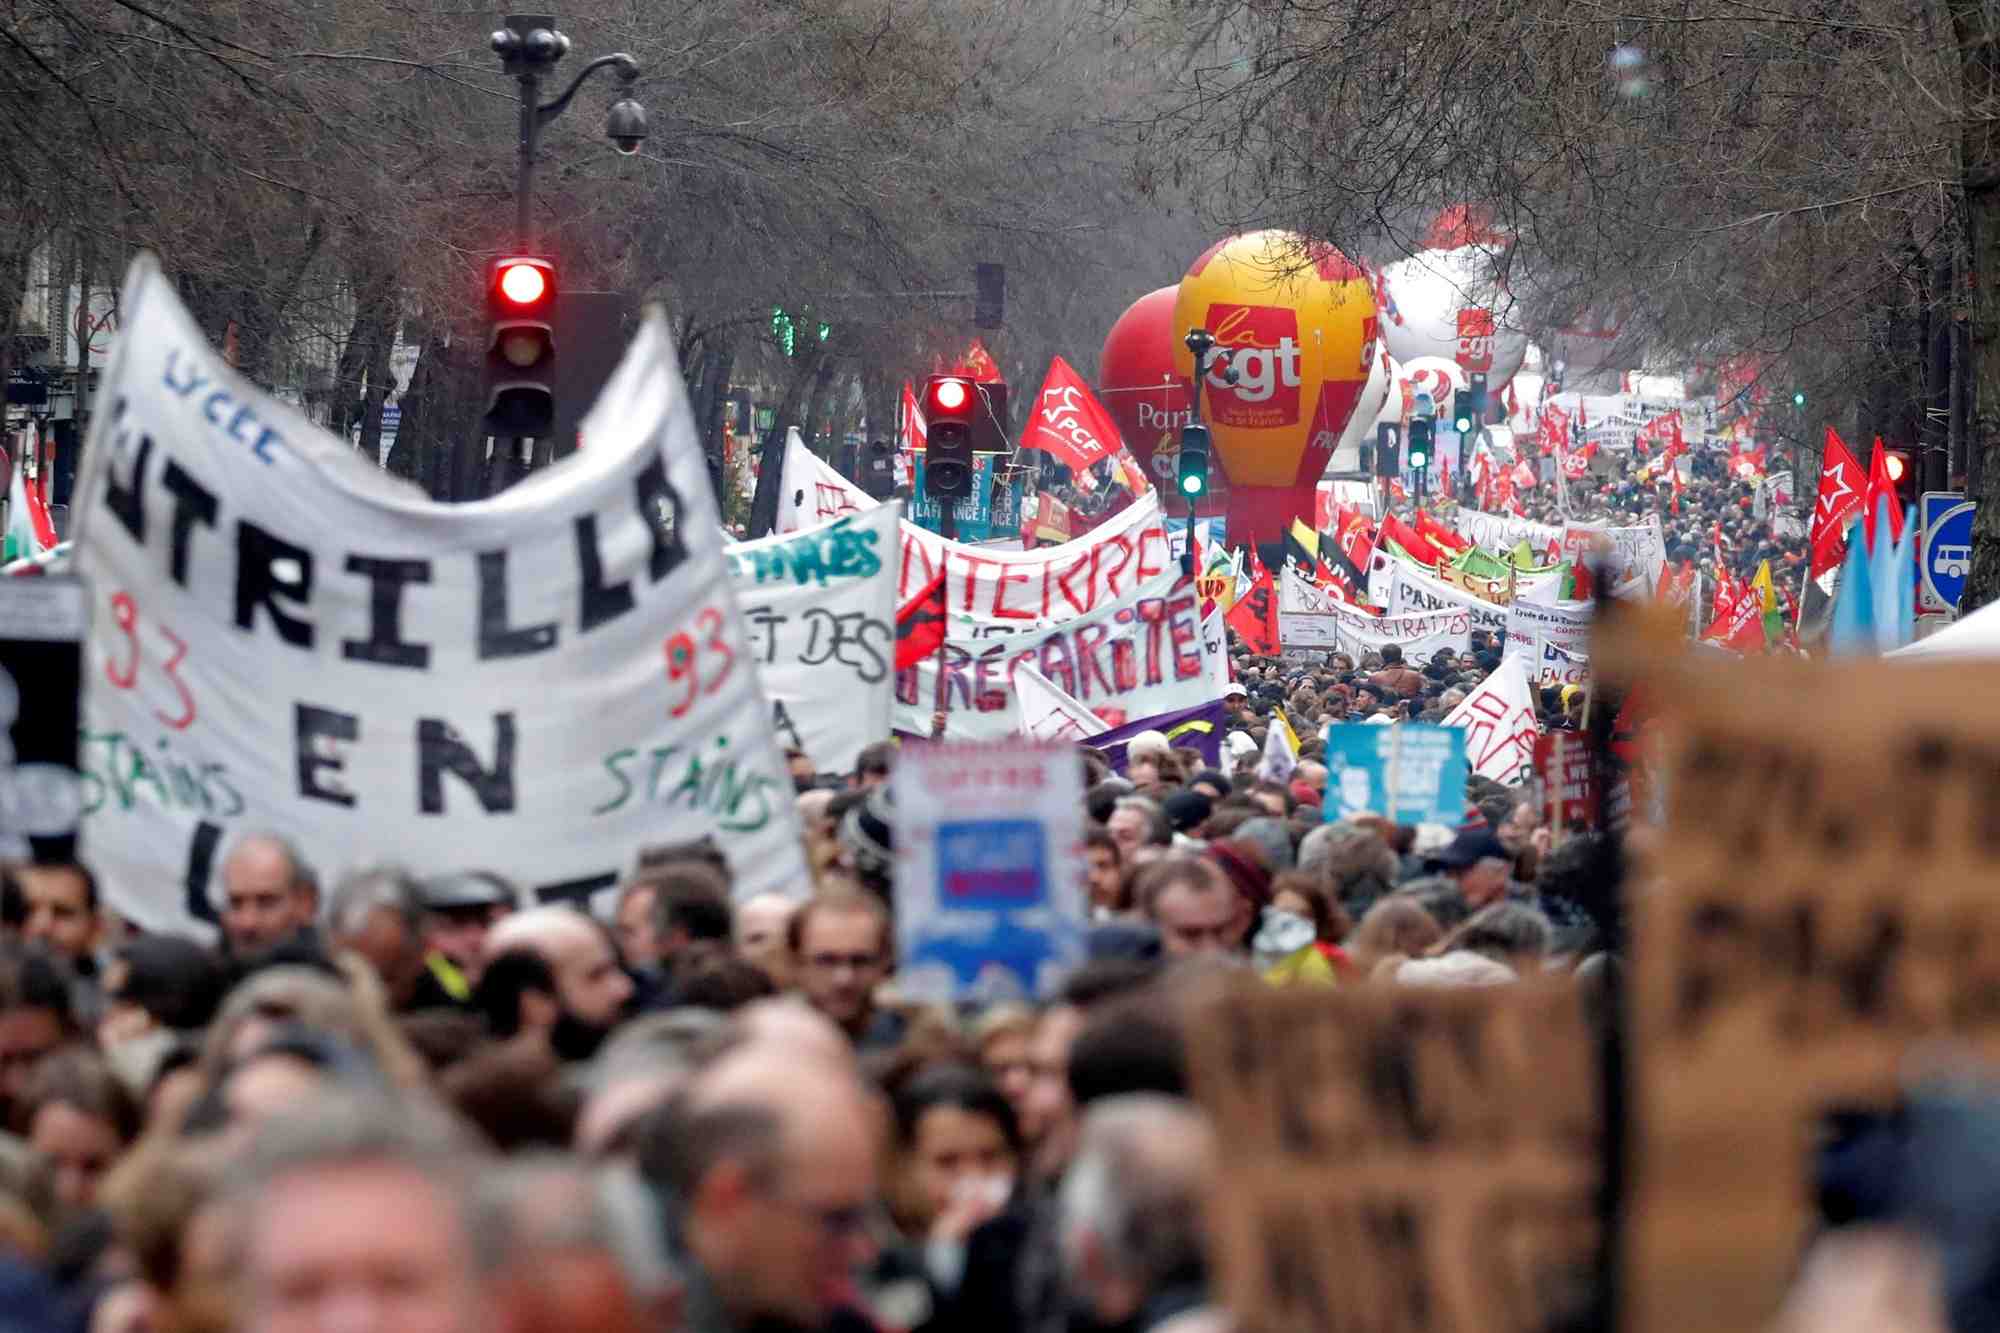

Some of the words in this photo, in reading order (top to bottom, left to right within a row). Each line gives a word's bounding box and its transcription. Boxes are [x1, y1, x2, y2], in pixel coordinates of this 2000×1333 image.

[1203, 336, 1301, 402] cgt
[663, 606, 738, 719] 93
[797, 606, 893, 686] DES
[294, 702, 518, 815] EN
